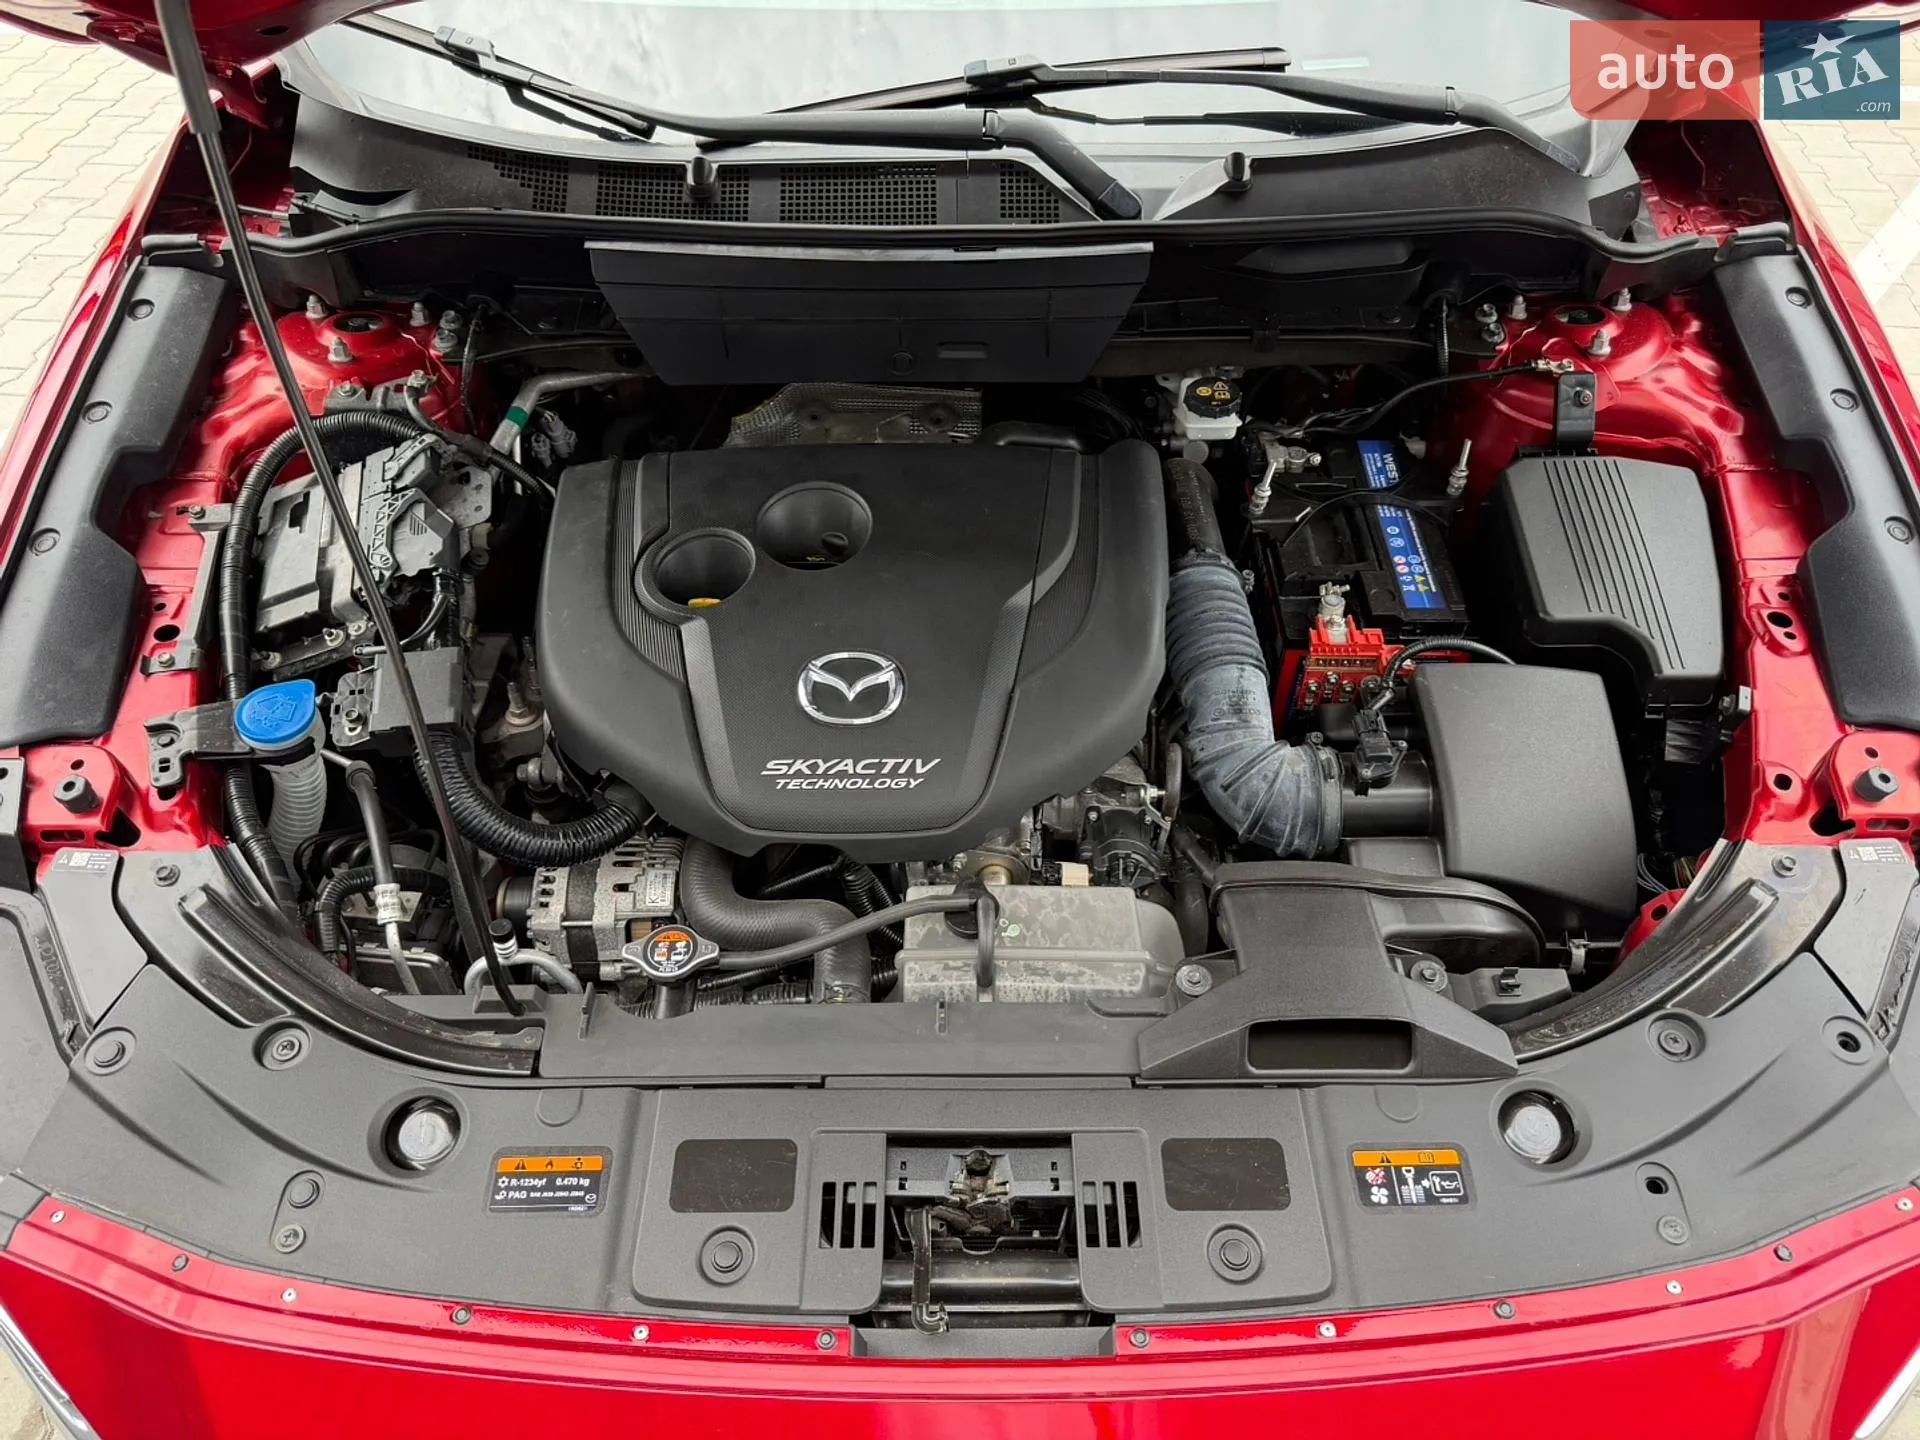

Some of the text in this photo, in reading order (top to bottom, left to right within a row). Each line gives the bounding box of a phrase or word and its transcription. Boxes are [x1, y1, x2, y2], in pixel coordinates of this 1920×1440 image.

[760, 758, 941, 775] SKYACTIV
[775, 778, 925, 790] TECHNOLOGY
[510, 1177, 590, 1188] R-1234yf 0.470 kg
[508, 1190, 527, 1199] PAG
